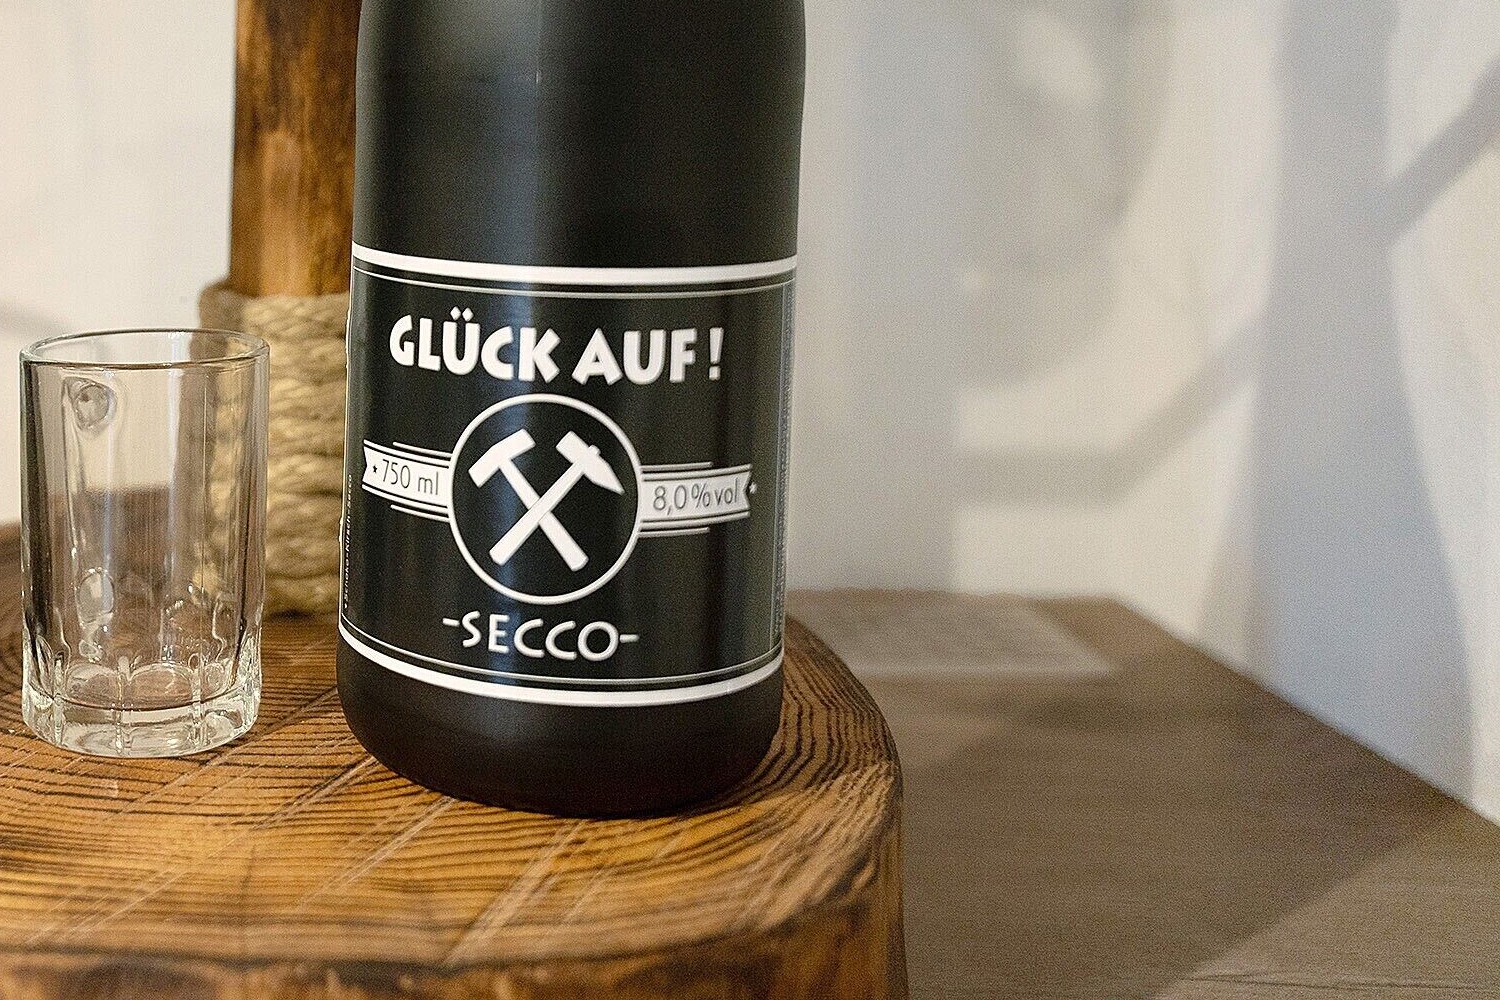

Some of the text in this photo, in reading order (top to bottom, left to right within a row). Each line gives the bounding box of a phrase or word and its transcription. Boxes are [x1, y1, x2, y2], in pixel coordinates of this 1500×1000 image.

[389, 305, 562, 384] GLÜCK
[382, 458, 439, 496] 750 ml
